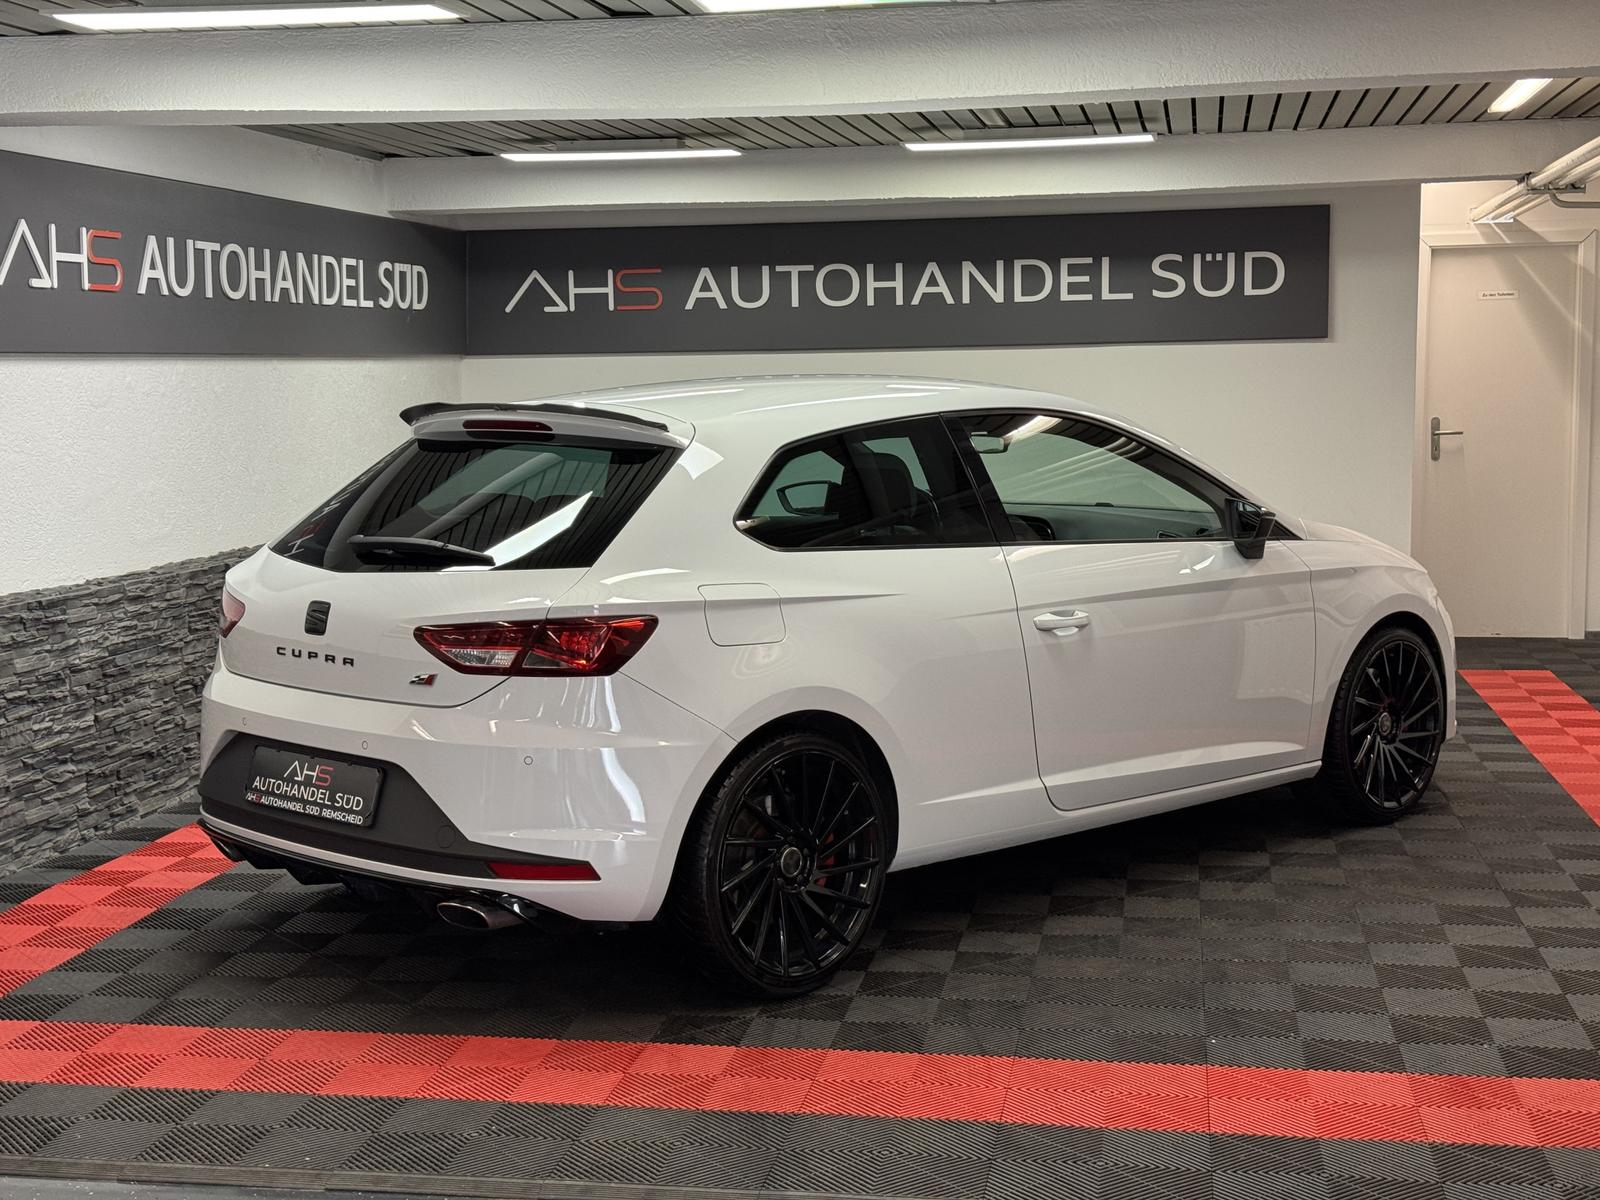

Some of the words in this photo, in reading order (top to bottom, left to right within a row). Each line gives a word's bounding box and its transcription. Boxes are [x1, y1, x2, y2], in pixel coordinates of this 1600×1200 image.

[0, 218, 123, 292] AHS
[137, 234, 374, 309] AUTOHANDEL
[377, 260, 430, 311] SÜD
[504, 268, 663, 314] AHS
[684, 256, 1134, 310] AUTOHANDEL
[1150, 250, 1287, 299] SÜD
[276, 646, 355, 668] CUPRA
[283, 760, 334, 787] AHS
[252, 775, 332, 805] AUTOHANDEL
[334, 792, 364, 811] SÜD
[260, 795, 305, 813] AUTOHANDEL
[305, 803, 320, 816] SÜD
[321, 808, 364, 825] REMSCHEID
